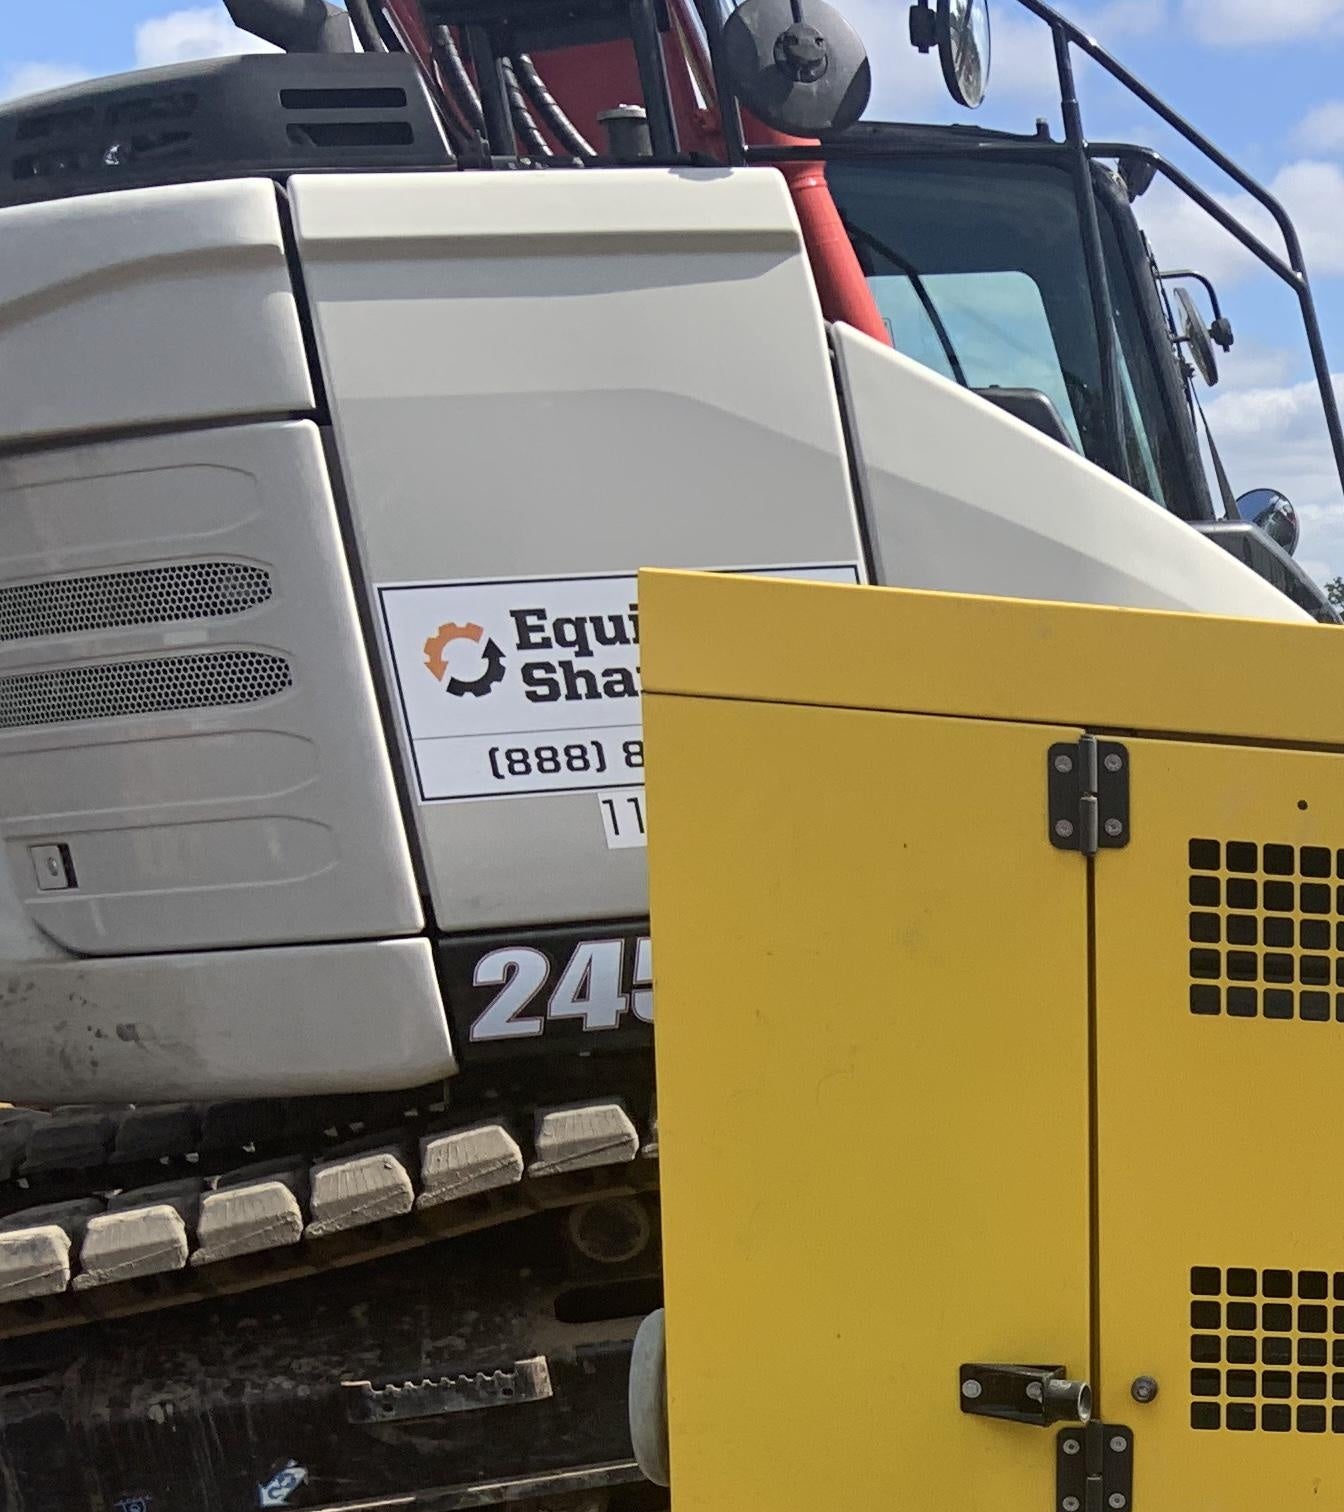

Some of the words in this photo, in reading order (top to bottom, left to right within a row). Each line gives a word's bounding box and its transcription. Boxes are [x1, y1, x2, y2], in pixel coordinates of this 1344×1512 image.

[521, 660, 640, 703] Sha
[488, 740, 607, 779] (888)
[602, 797, 645, 836] 11
